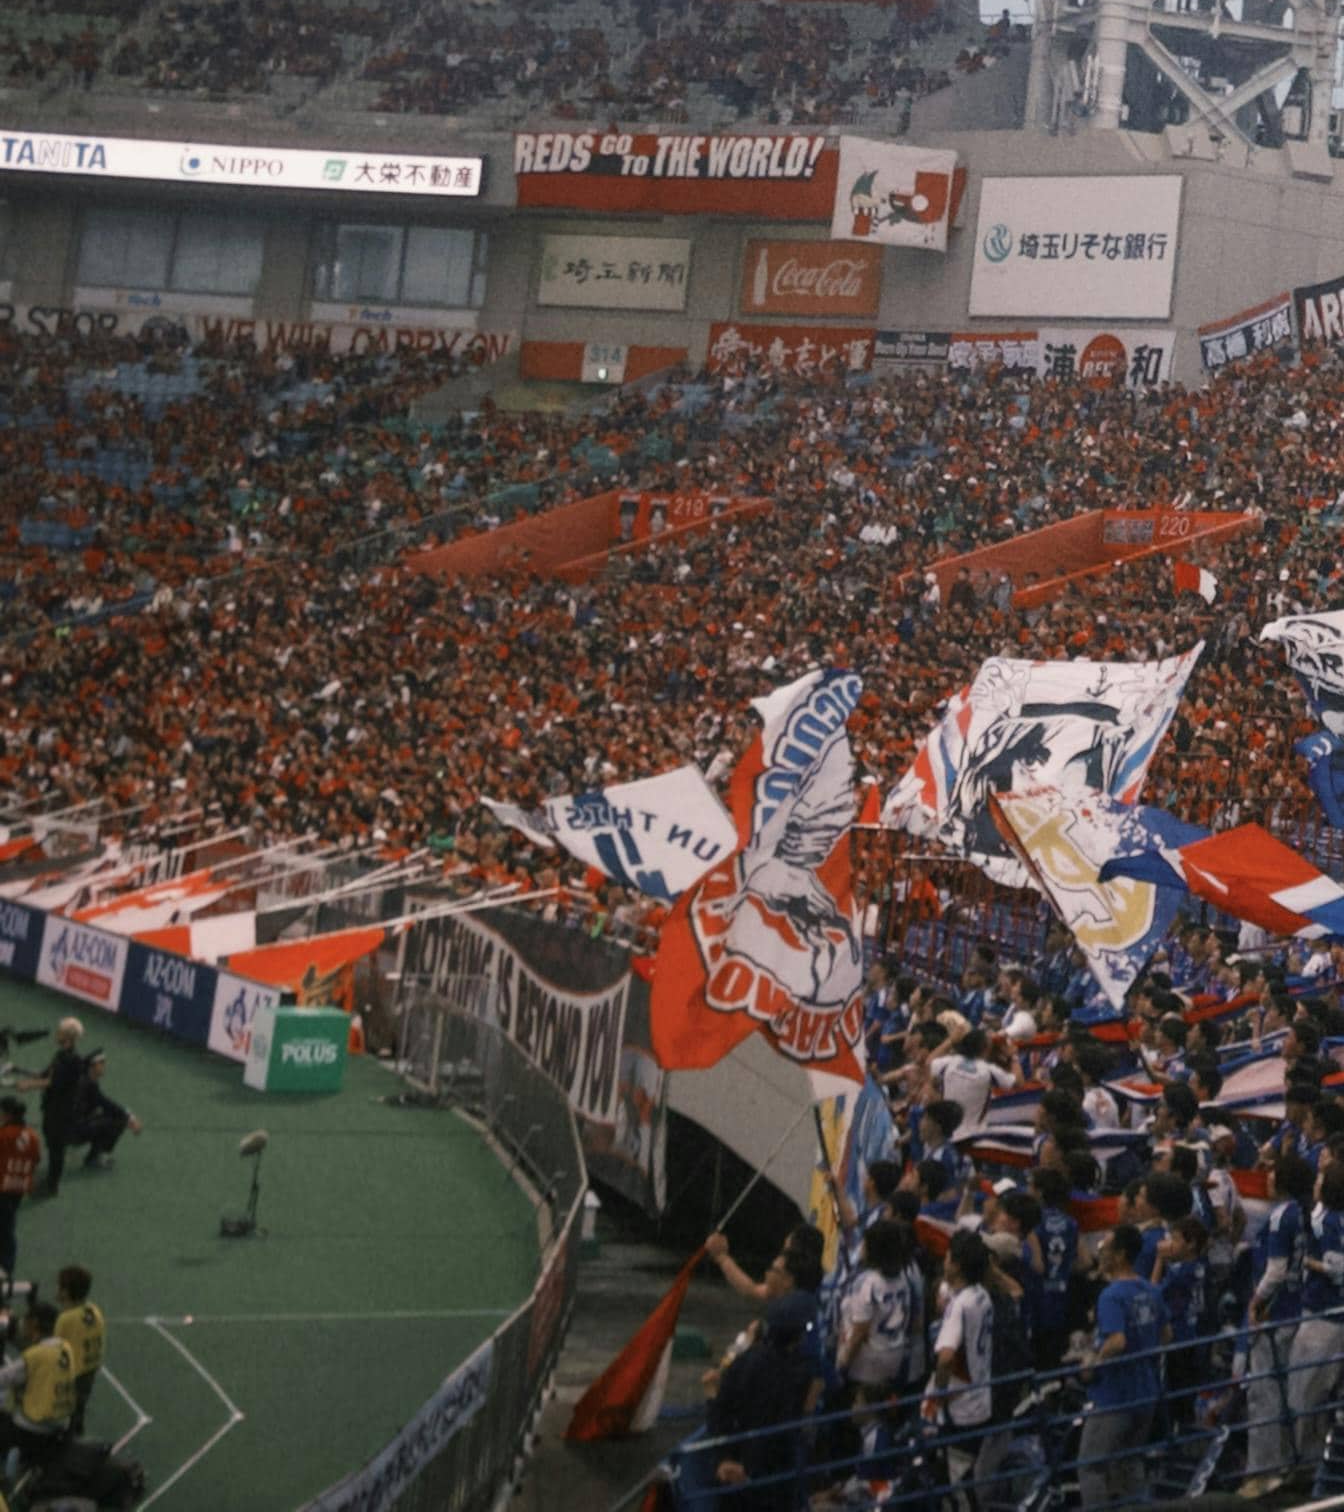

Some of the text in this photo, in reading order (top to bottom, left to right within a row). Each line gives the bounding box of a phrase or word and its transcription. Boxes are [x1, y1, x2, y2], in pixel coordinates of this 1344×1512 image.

[1, 137, 107, 169] TANITA
[212, 156, 284, 177] NIPPO
[514, 133, 633, 173] REDS GO
[621, 136, 825, 178] TO THE WORLD!
[354, 160, 473, 188] 大栄不動産
[1017, 230, 1168, 261] 埼玉りそな銀行
[1130, 344, 1163, 386] 和
[1161, 516, 1190, 536] 220
